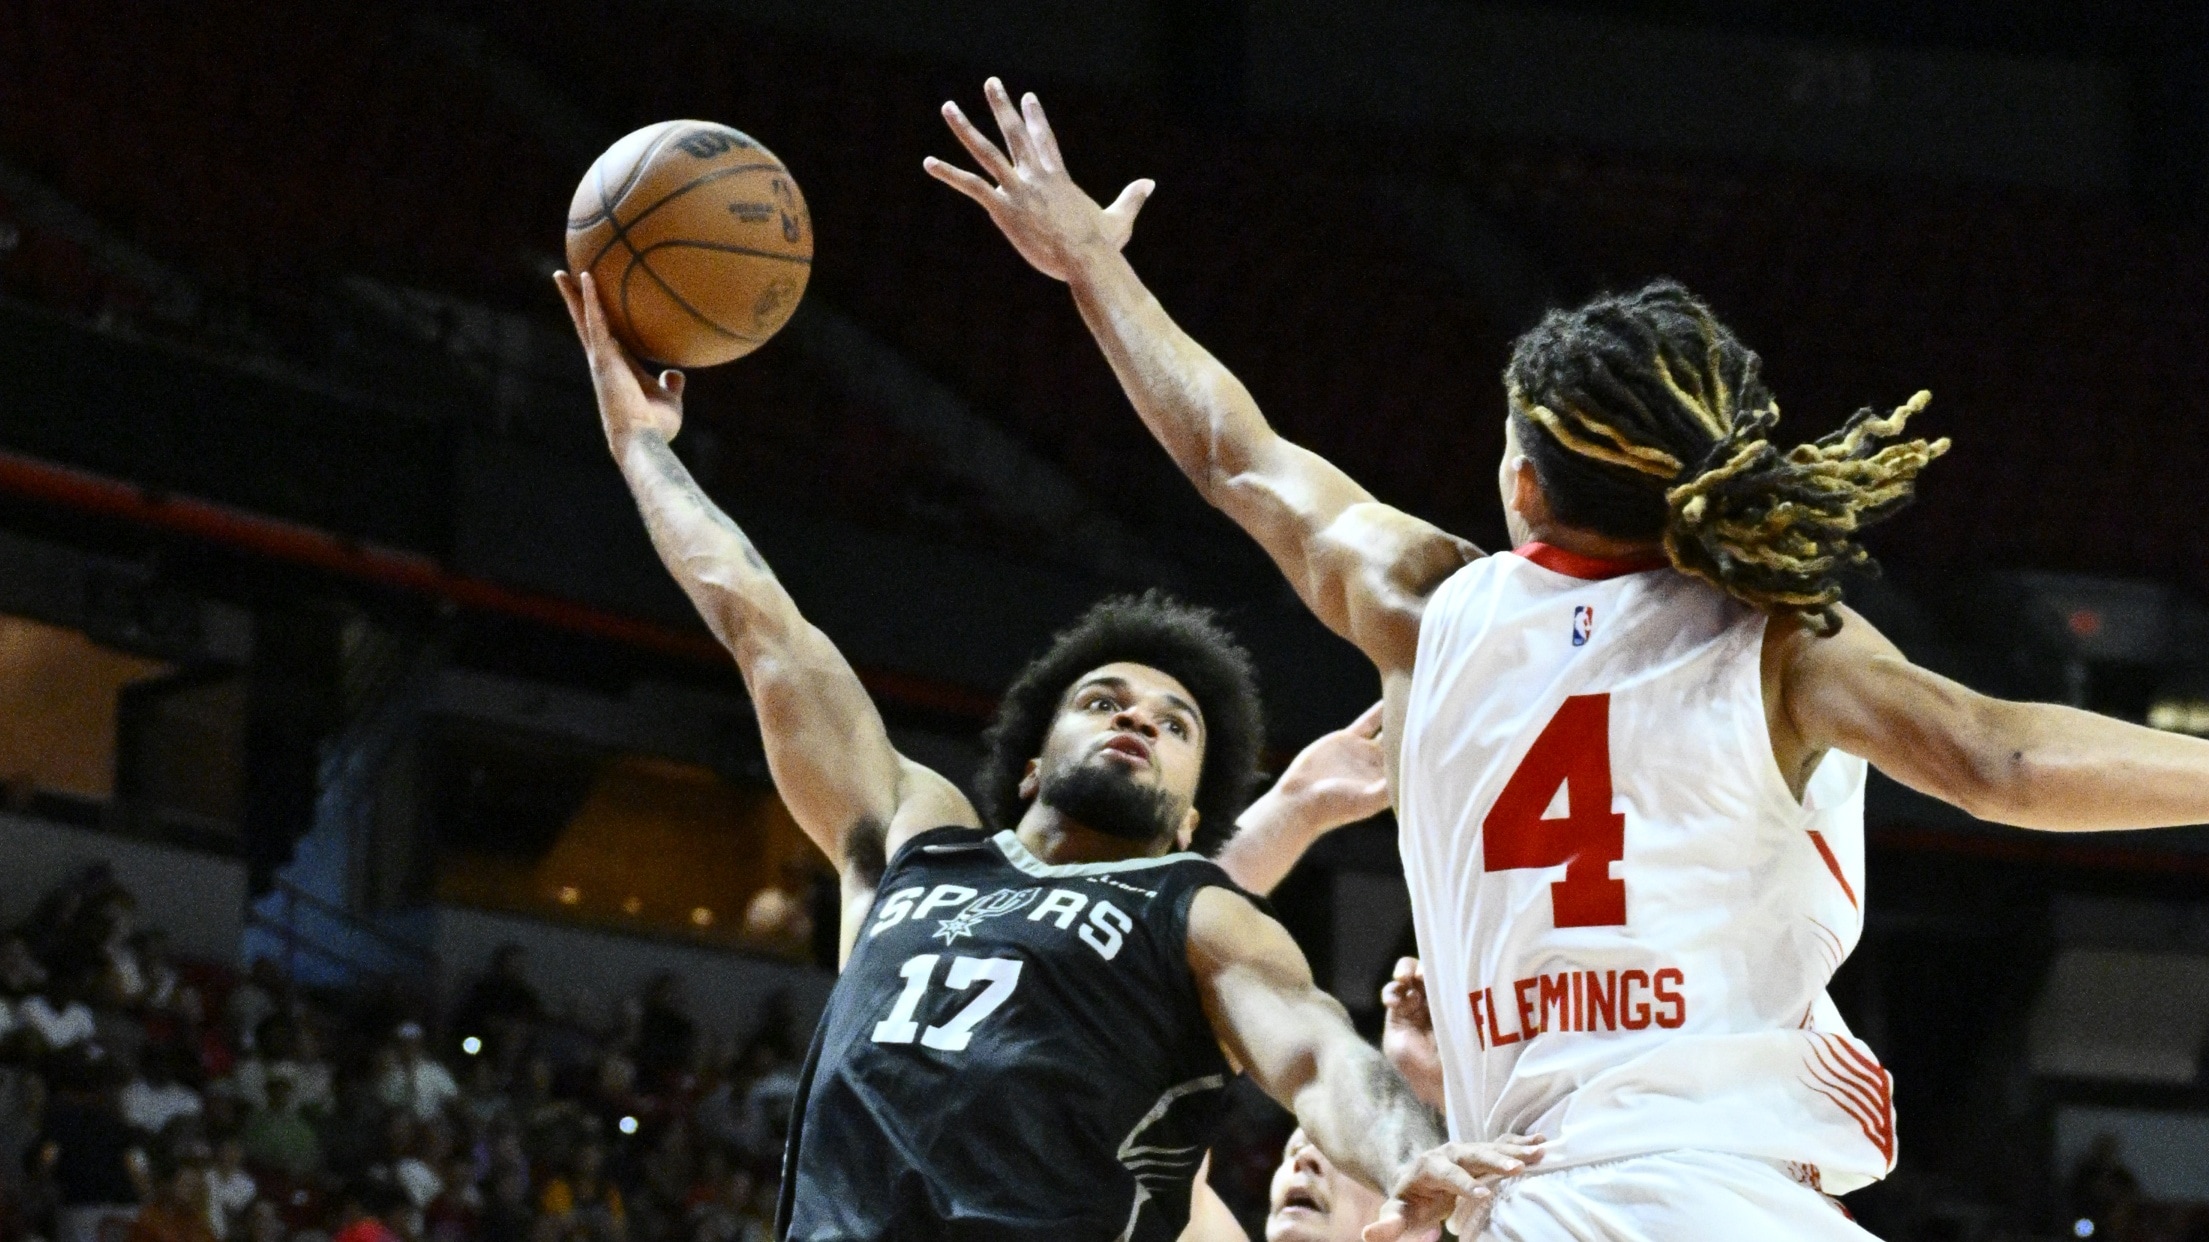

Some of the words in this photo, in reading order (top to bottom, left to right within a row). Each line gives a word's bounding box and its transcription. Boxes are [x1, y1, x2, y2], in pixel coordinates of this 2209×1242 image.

[1483, 692, 1627, 929] 4
[871, 954, 1023, 1051] 17
[1468, 967, 1686, 1051] FLEMINGS
